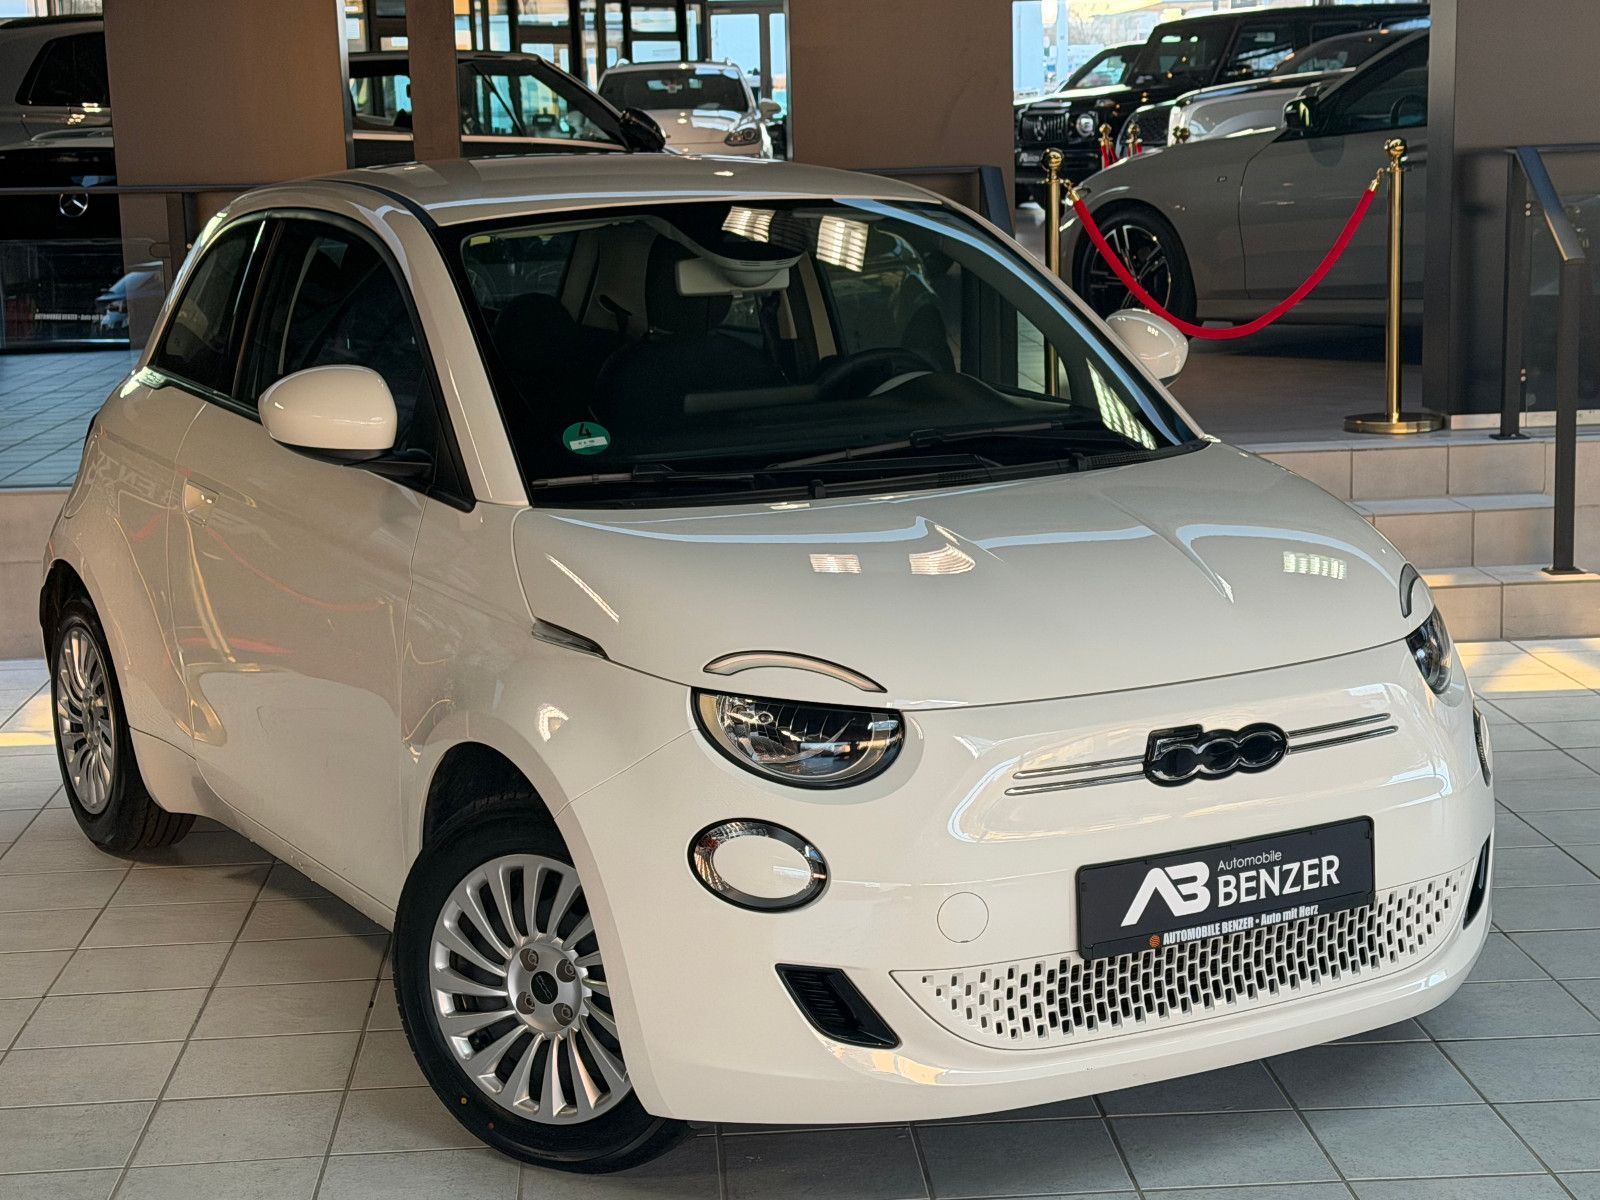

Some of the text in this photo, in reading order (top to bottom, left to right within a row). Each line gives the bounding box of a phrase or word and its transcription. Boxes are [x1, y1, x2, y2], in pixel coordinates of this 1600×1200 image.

[579, 423, 592, 438] 4
[1143, 722, 1288, 788] 500
[1217, 850, 1282, 871] Automobile
[1217, 855, 1340, 907] BENZER
[1162, 904, 1319, 945] AUTOMOBILE BENZER Auto mit Herz
